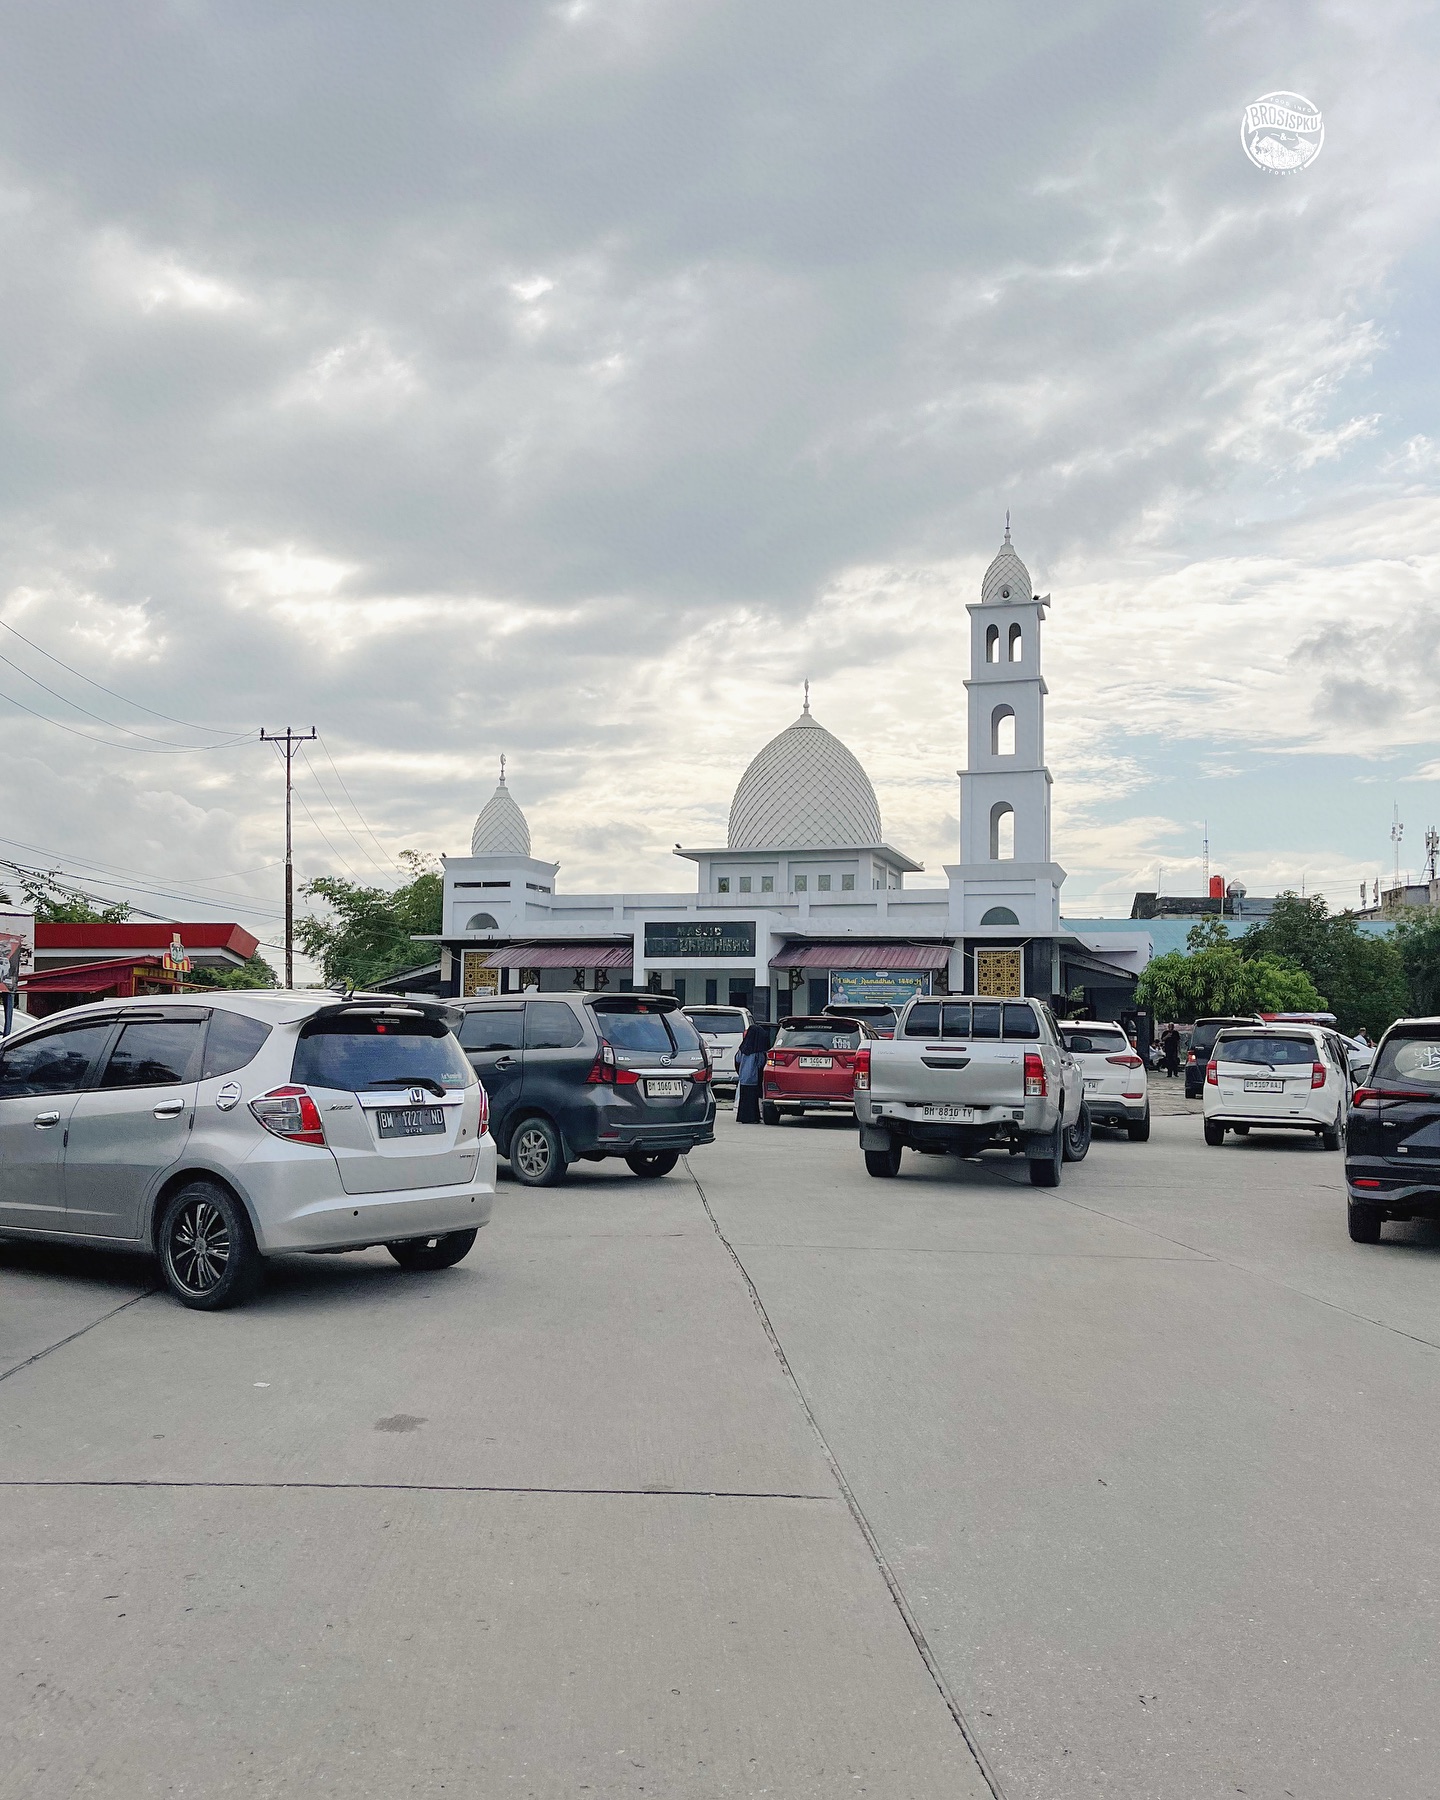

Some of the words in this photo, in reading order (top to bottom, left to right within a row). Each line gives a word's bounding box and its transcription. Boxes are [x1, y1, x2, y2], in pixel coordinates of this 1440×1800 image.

[676, 926, 722, 936] MASJID
[647, 1081, 656, 1091] BM
[657, 1081, 672, 1091] 1060
[924, 1106, 935, 1116] BM
[938, 1107, 959, 1117] 8810
[962, 1108, 973, 1118] TY
[380, 1112, 394, 1128] BM
[402, 1110, 423, 1126] 1727
[430, 1109, 444, 1125] ND
